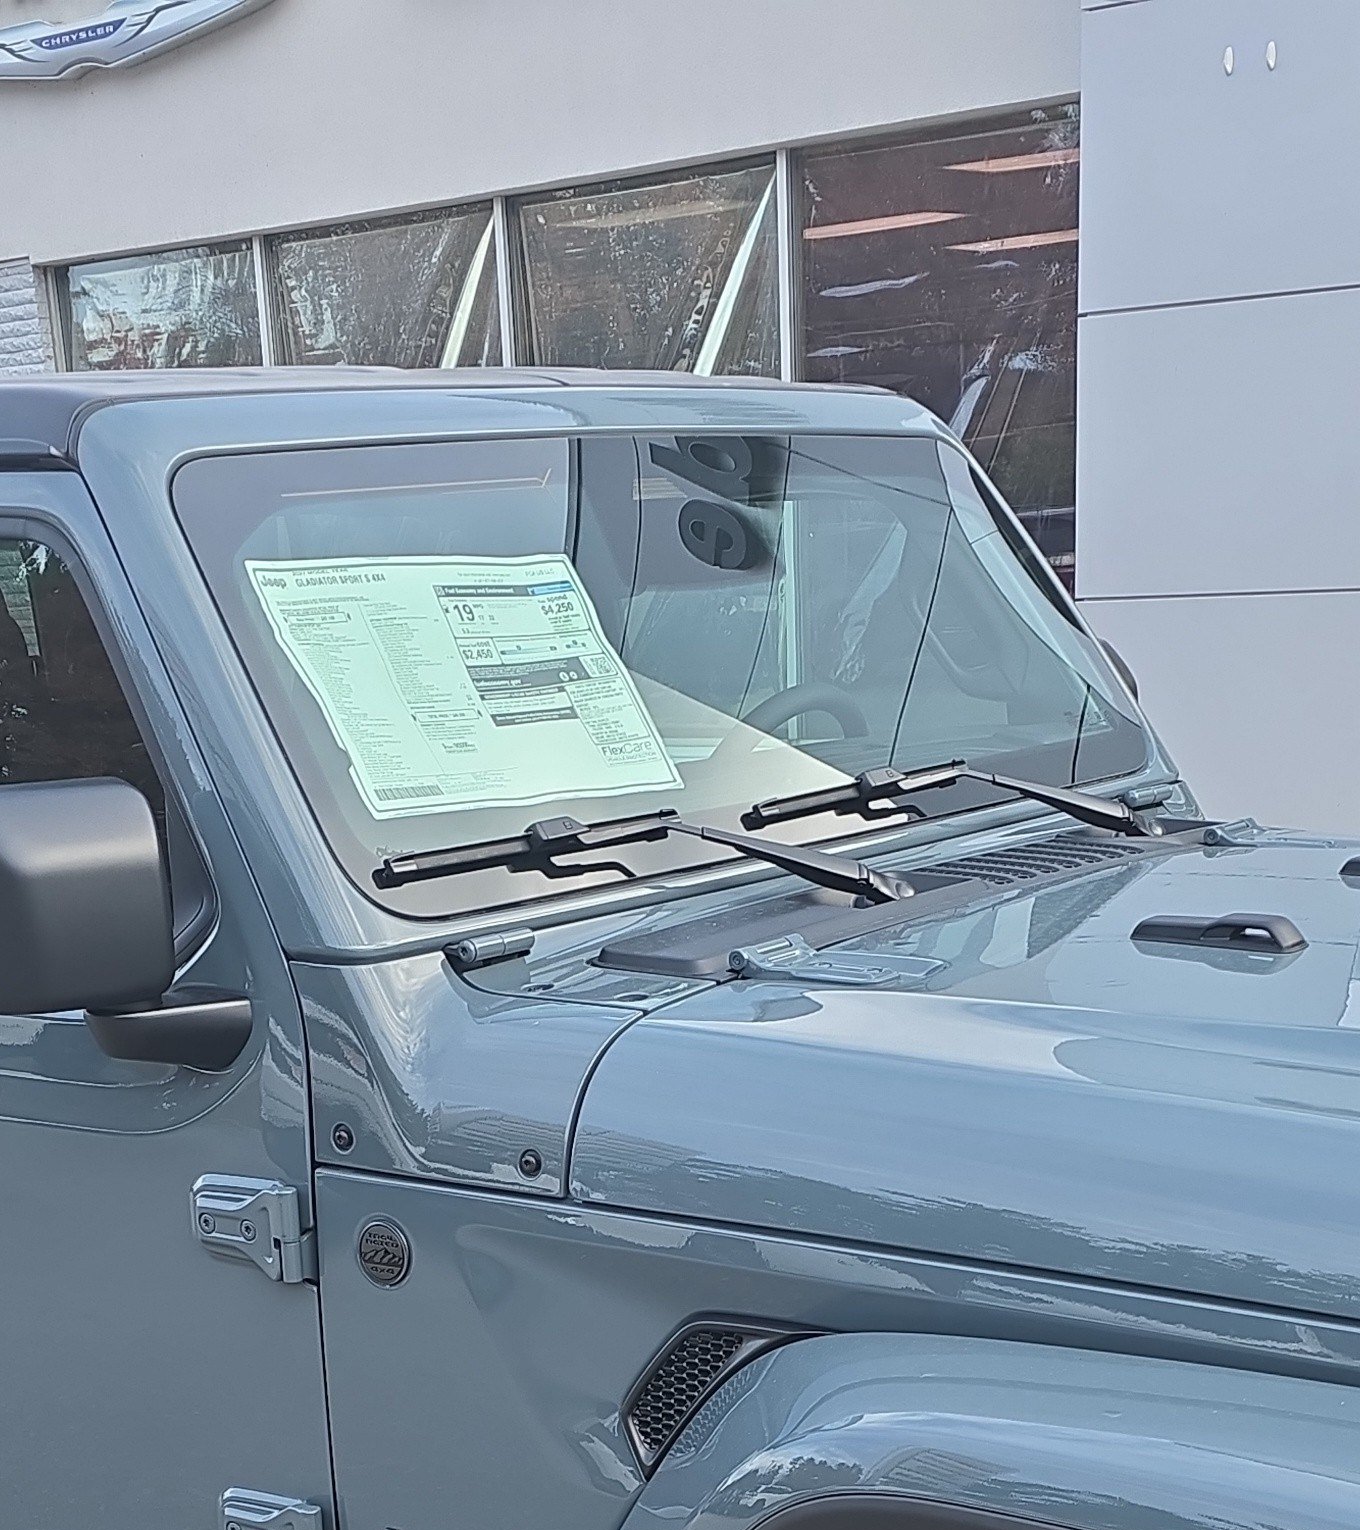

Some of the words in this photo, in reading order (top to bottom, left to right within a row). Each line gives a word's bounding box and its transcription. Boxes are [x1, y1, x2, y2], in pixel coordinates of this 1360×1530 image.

[41, 24, 114, 47] CHRYSLER
[260, 575, 287, 590] Jeep
[295, 575, 339, 588] GLADIATOR
[453, 603, 475, 622] 19
[540, 601, 574, 616] $4,250
[462, 648, 493, 660] $2,450
[600, 740, 652, 757] FlexCare
